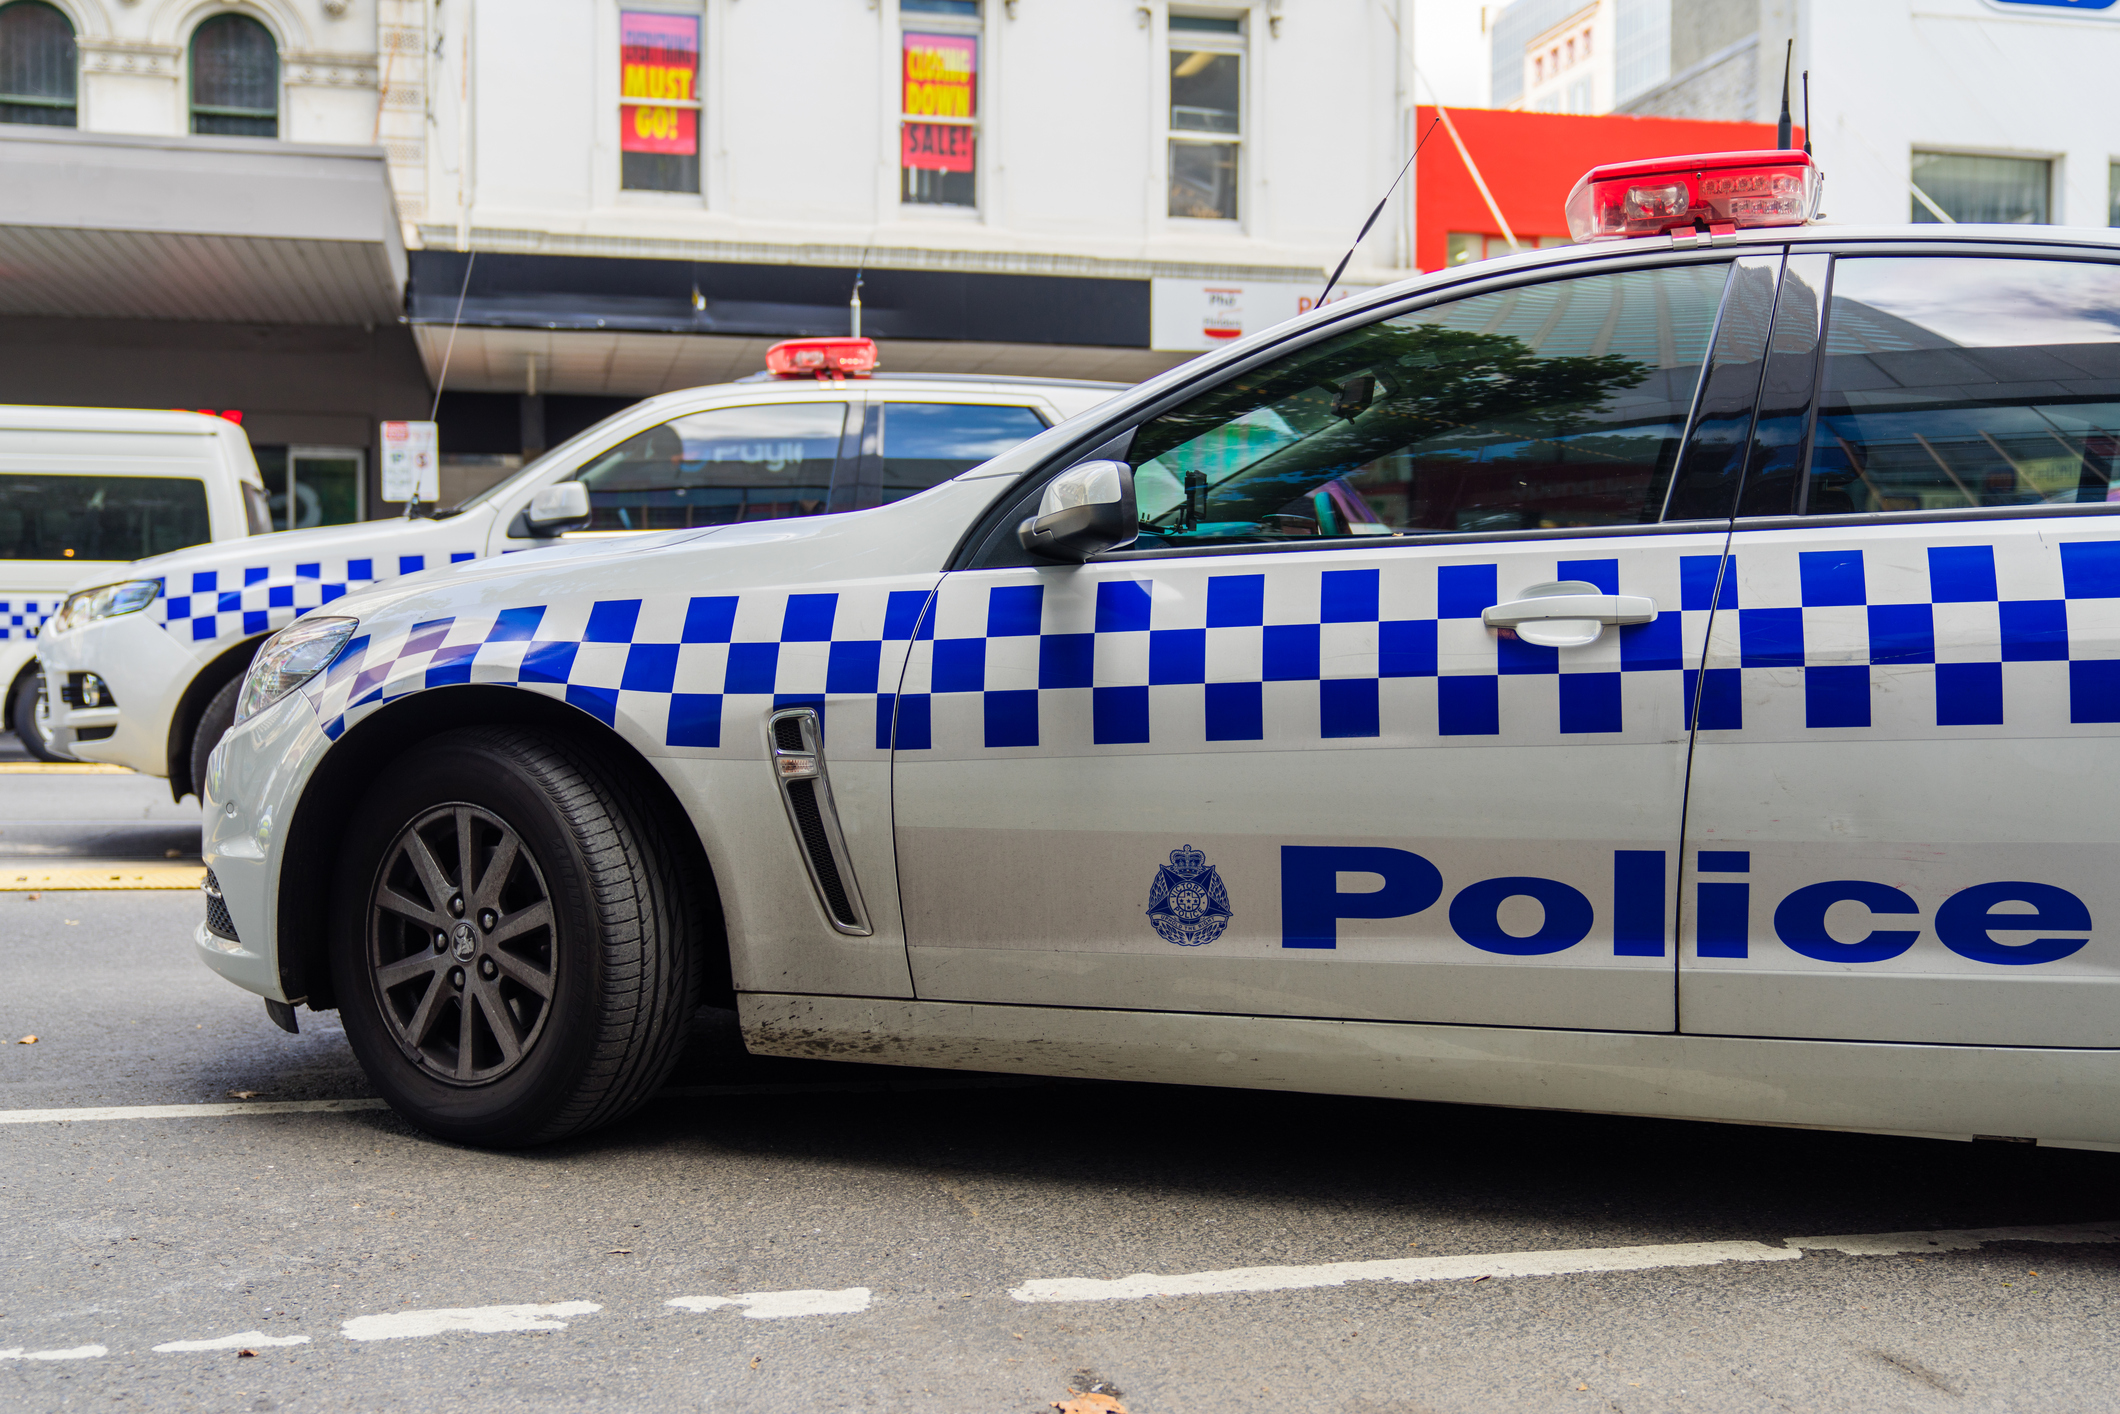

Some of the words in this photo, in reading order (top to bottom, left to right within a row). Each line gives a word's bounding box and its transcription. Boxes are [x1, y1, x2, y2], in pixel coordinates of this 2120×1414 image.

[906, 45, 971, 83] CLOSING
[624, 64, 693, 99] MUST
[906, 82, 970, 117] DOWN
[634, 106, 678, 140] GO!
[909, 124, 968, 157] SALE!
[1170, 882, 1206, 899] VICTORIA
[1281, 845, 2092, 965] Police
[1160, 914, 1182, 929] UPHOLD
[1173, 906, 1205, 919] POLICE
